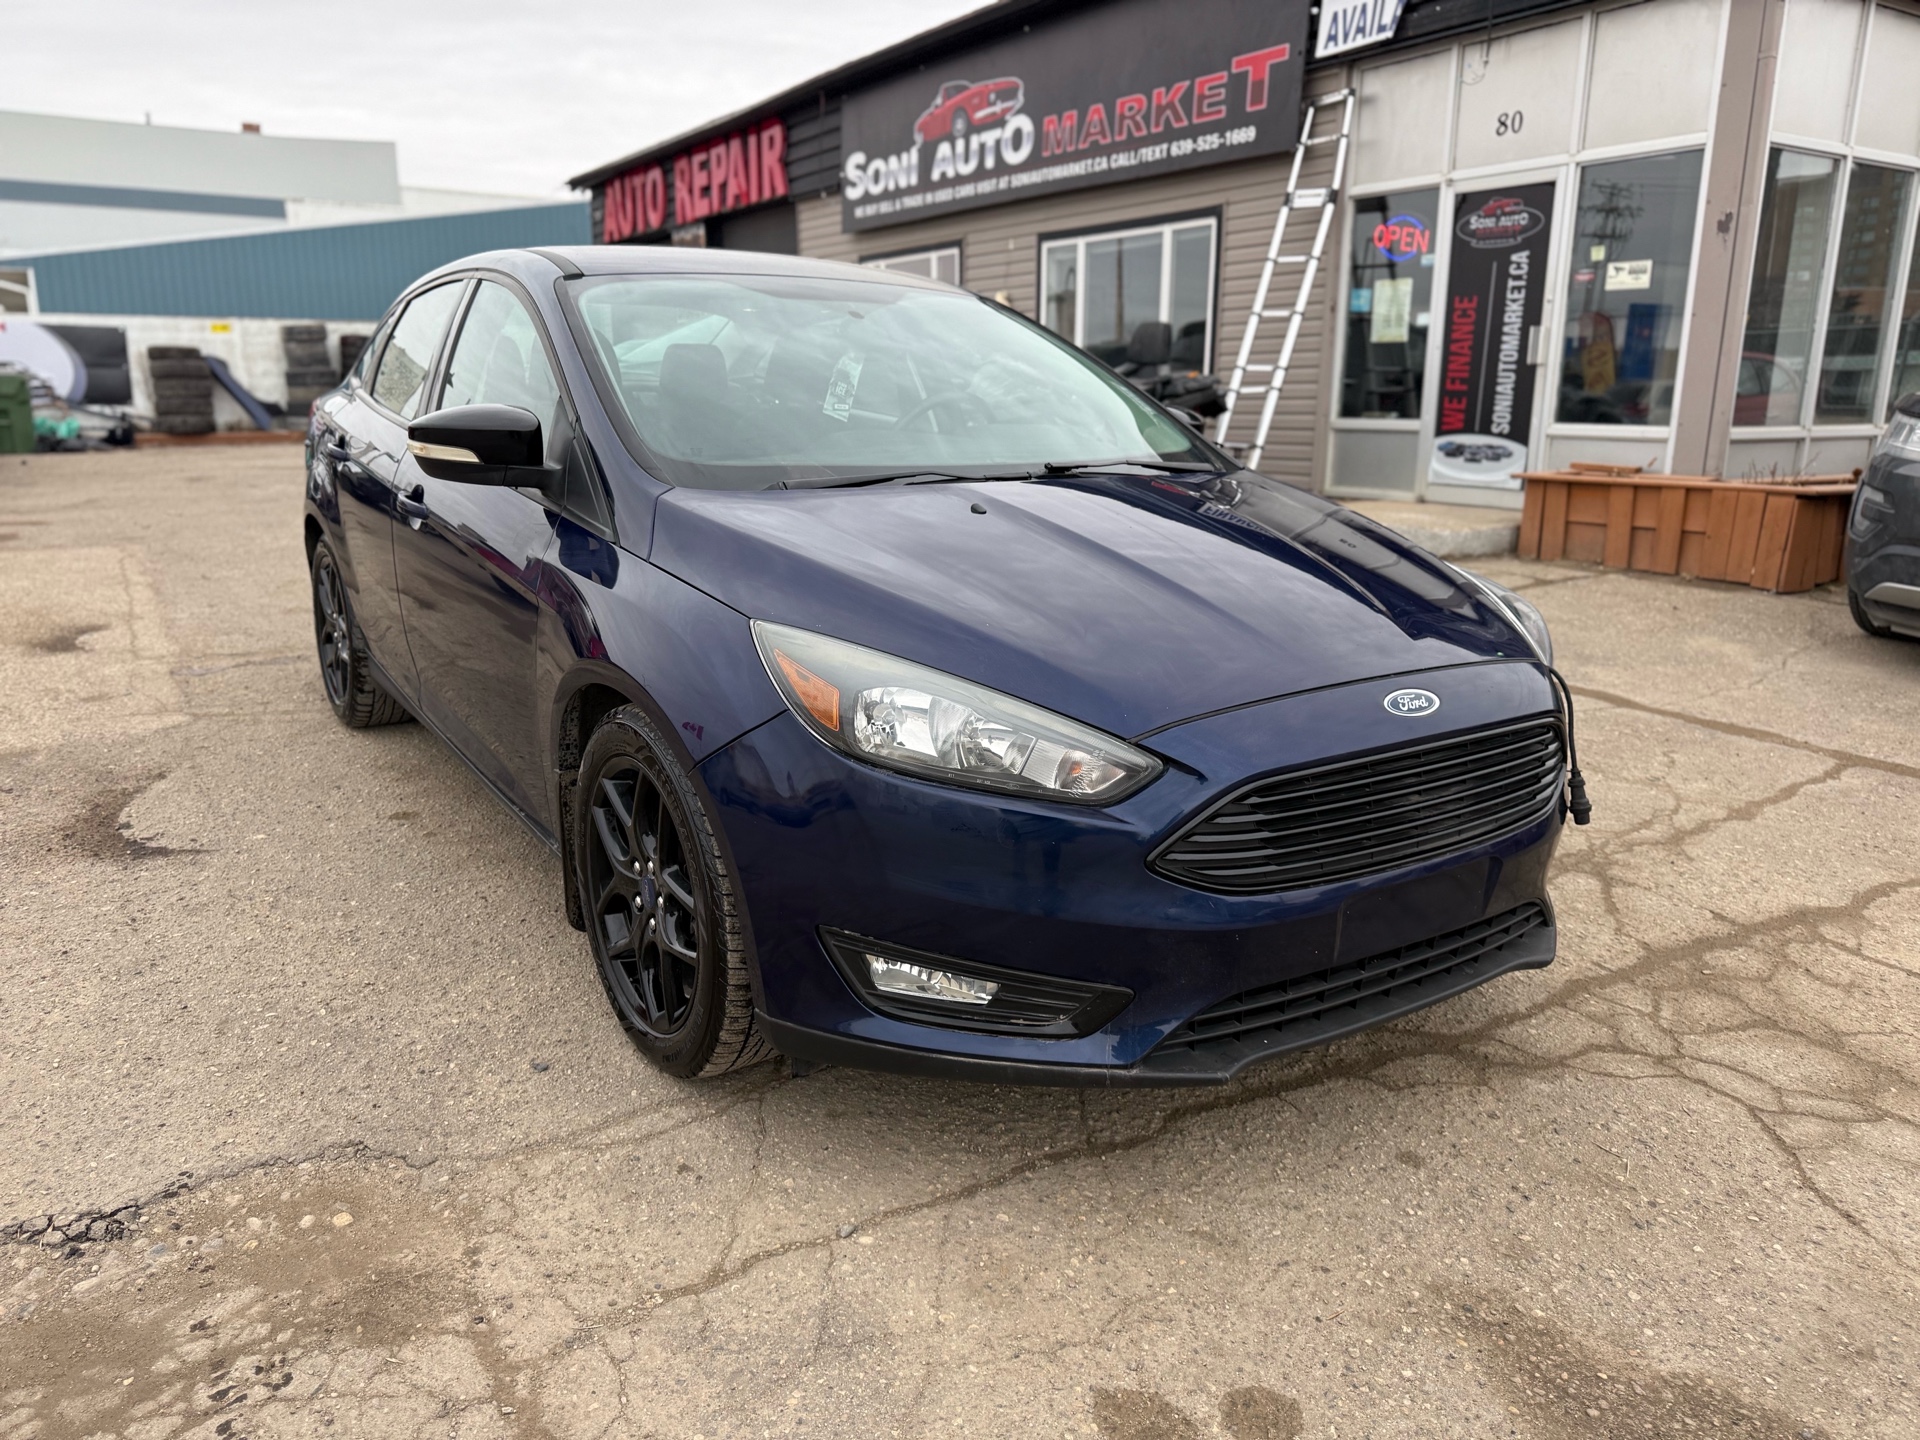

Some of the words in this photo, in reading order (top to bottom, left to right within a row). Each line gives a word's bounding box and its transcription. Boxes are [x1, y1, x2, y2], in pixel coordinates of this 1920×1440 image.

[931, 113, 1035, 182] AUTO
[1041, 43, 1290, 157] MARKET
[1496, 110, 1523, 137] 80
[1110, 142, 1169, 169] CALL/TEXT
[603, 162, 667, 243] AUTO
[673, 117, 789, 226] REPAIR
[1373, 223, 1430, 254] OPEN
[1446, 295, 1478, 391] FINANCE
[1491, 250, 1530, 434] SONIAUTOMARKET.CA
[1441, 396, 1468, 431] WE
[1397, 694, 1428, 711] Ford
